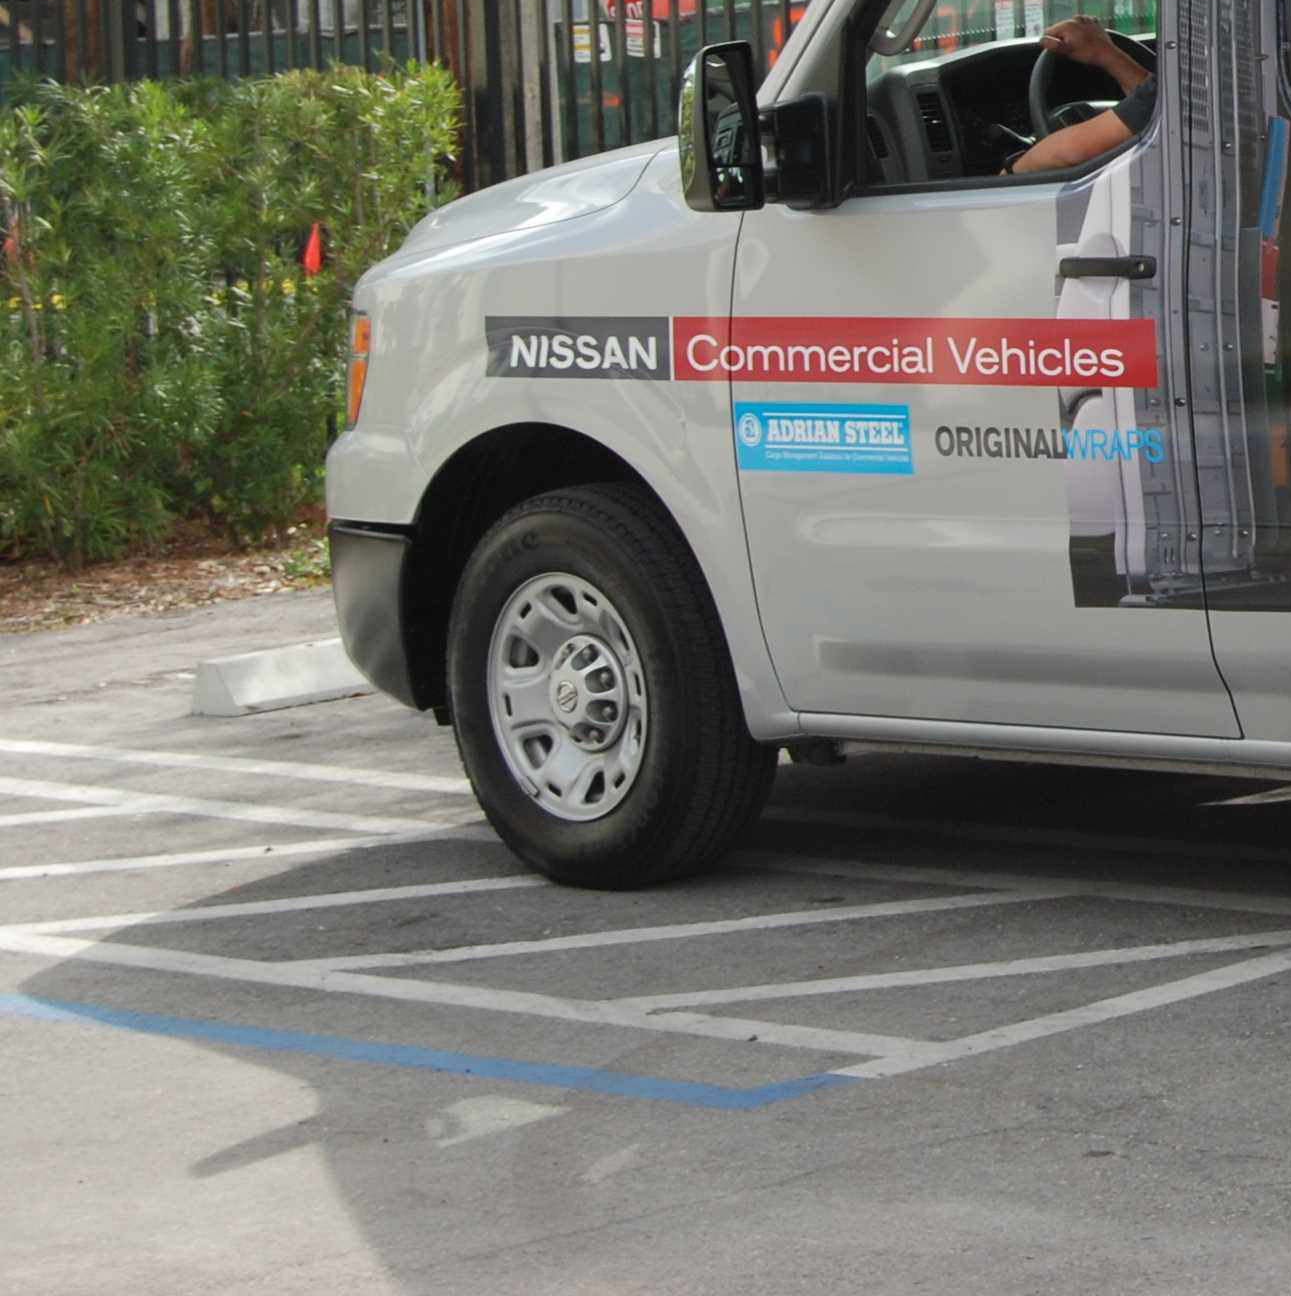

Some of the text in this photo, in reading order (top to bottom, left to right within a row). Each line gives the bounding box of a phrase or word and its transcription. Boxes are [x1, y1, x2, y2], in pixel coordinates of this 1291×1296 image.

[510, 335, 657, 369] NISSAN
[687, 334, 1125, 377] Commercial Vehicles
[767, 419, 905, 445] ADRIAN STEEL
